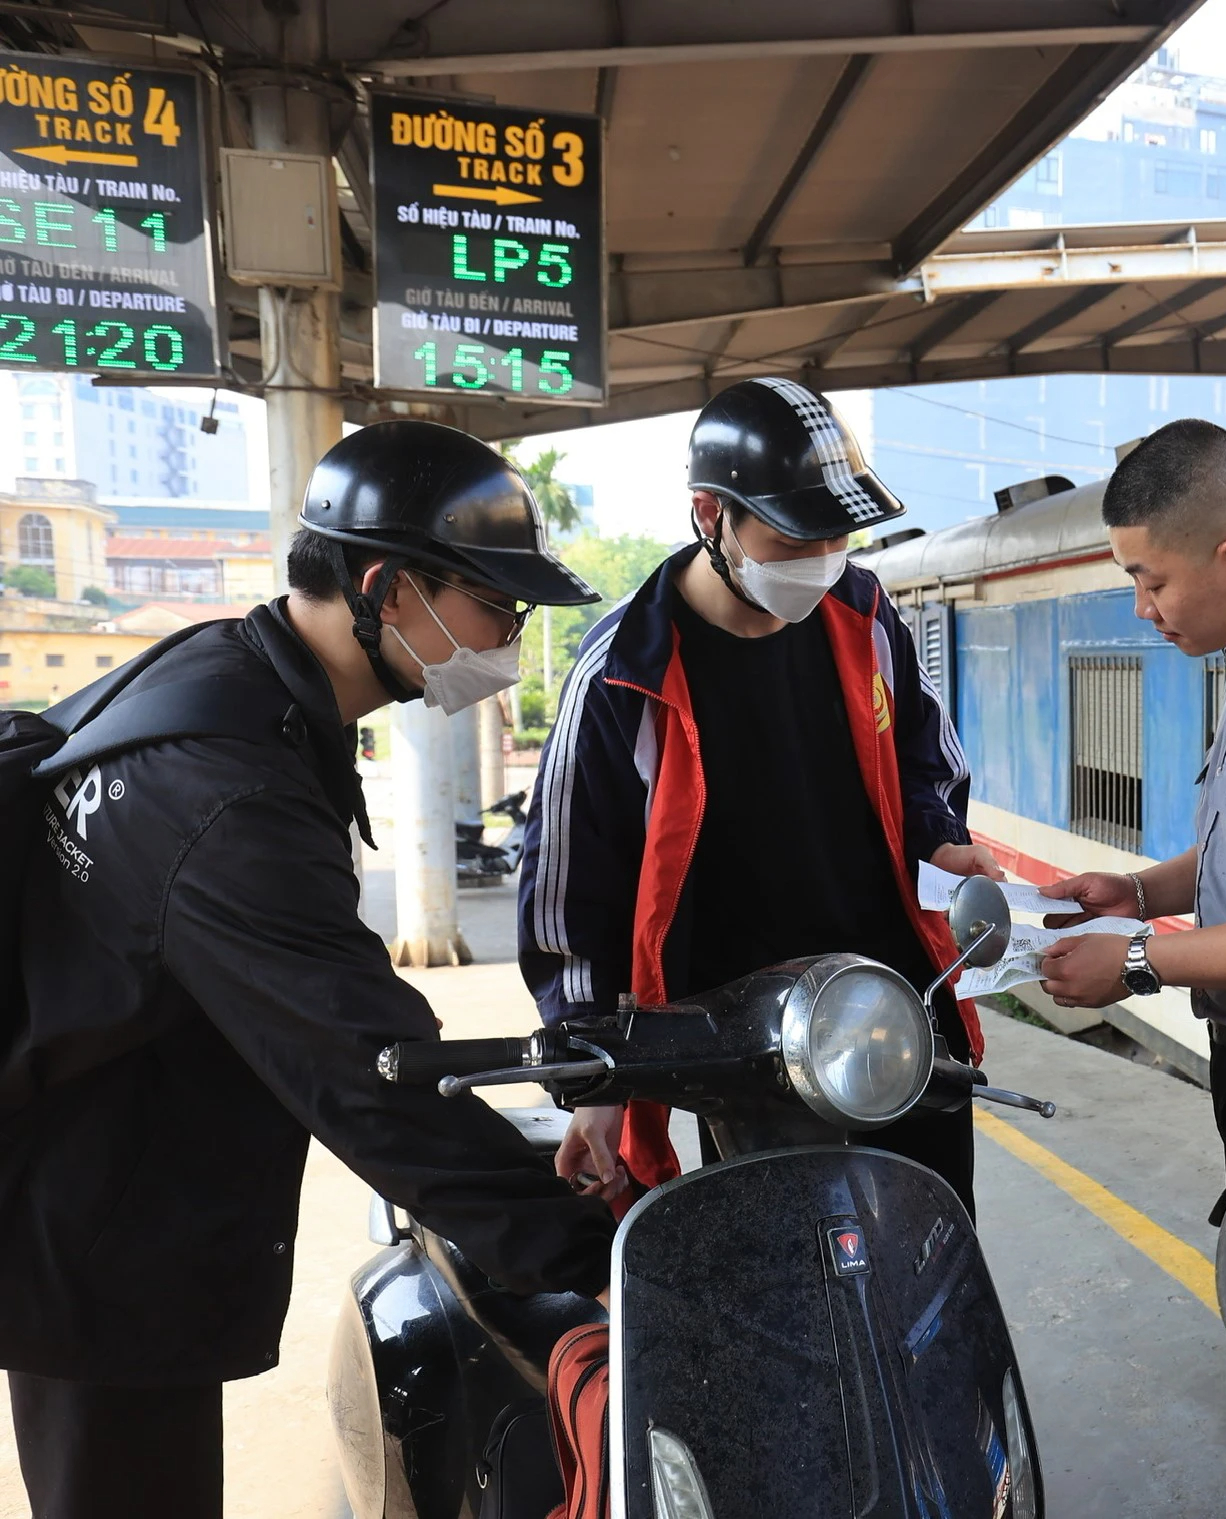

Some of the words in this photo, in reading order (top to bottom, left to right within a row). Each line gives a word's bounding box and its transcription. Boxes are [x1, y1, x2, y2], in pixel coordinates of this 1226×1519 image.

[0, 64, 78, 112] ỜNG
[87, 72, 134, 117] SỐ
[143, 88, 181, 147] 4
[34, 114, 134, 146] TRACK
[391, 109, 497, 156] ĐƯỜNG
[504, 118, 546, 160] SỐ
[552, 131, 584, 187] 3
[44, 172, 79, 194] TÀU
[96, 179, 149, 200] TRAIN
[152, 184, 181, 203] No.
[457, 156, 543, 186] TRACK
[0, 198, 166, 252] SE11
[397, 201, 420, 223] SỐ
[422, 206, 459, 229] HIỆU
[461, 209, 492, 230] TÀU
[505, 215, 552, 236] TRAIN
[554, 219, 581, 240] No.
[109, 265, 179, 287] ARRIVAL
[453, 234, 572, 288] LP5
[17, 282, 51, 305] TÀU
[55, 287, 75, 306] ĐI
[89, 289, 187, 313] DEPARTURE
[405, 288, 432, 306] GIỜ
[435, 288, 465, 309] TÀU
[468, 290, 499, 312] ĐẾN
[512, 297, 574, 318] ARRIVAL
[0, 314, 184, 371] 21:20
[401, 310, 429, 330] GIỜ
[430, 313, 461, 333] TÀU
[463, 317, 482, 335] ĐI
[493, 318, 579, 342] DEPARTURE
[414, 342, 573, 394] 15:15
[46, 829, 71, 870] Version
[71, 864, 90, 883] 2.0
[56, 828, 94, 869] JACKET
[841, 1259, 866, 1269] LIMA
